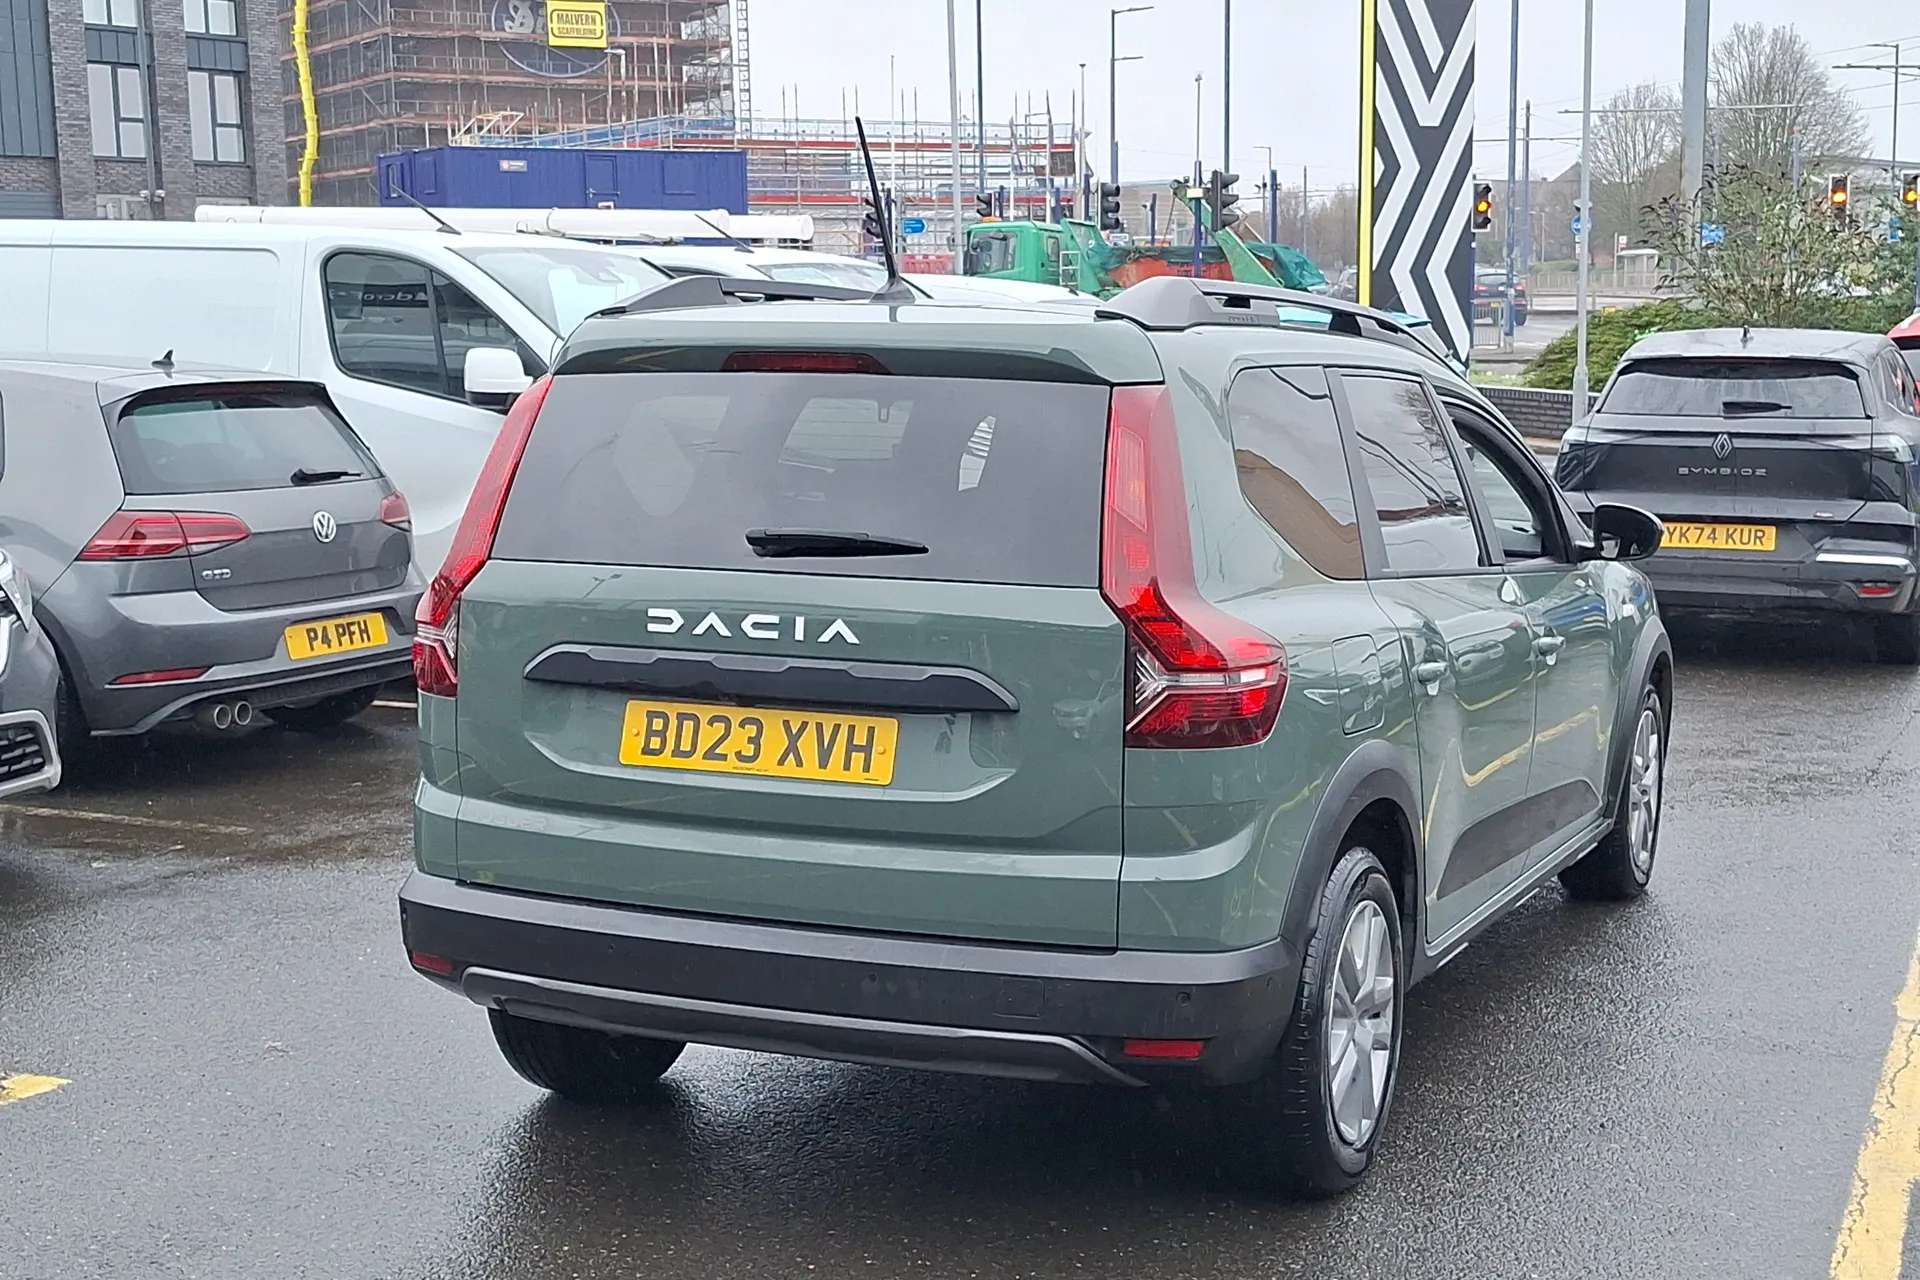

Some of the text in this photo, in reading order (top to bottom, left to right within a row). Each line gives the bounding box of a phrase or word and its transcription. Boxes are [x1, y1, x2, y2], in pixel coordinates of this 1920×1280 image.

[556, 13, 597, 26] MALVERN
[1666, 526, 1766, 546] YK74 KUR
[202, 568, 231, 580] GTD
[306, 619, 371, 652] P4 PFH
[647, 608, 860, 644] DACIA
[641, 709, 876, 773] BD23 XVH
